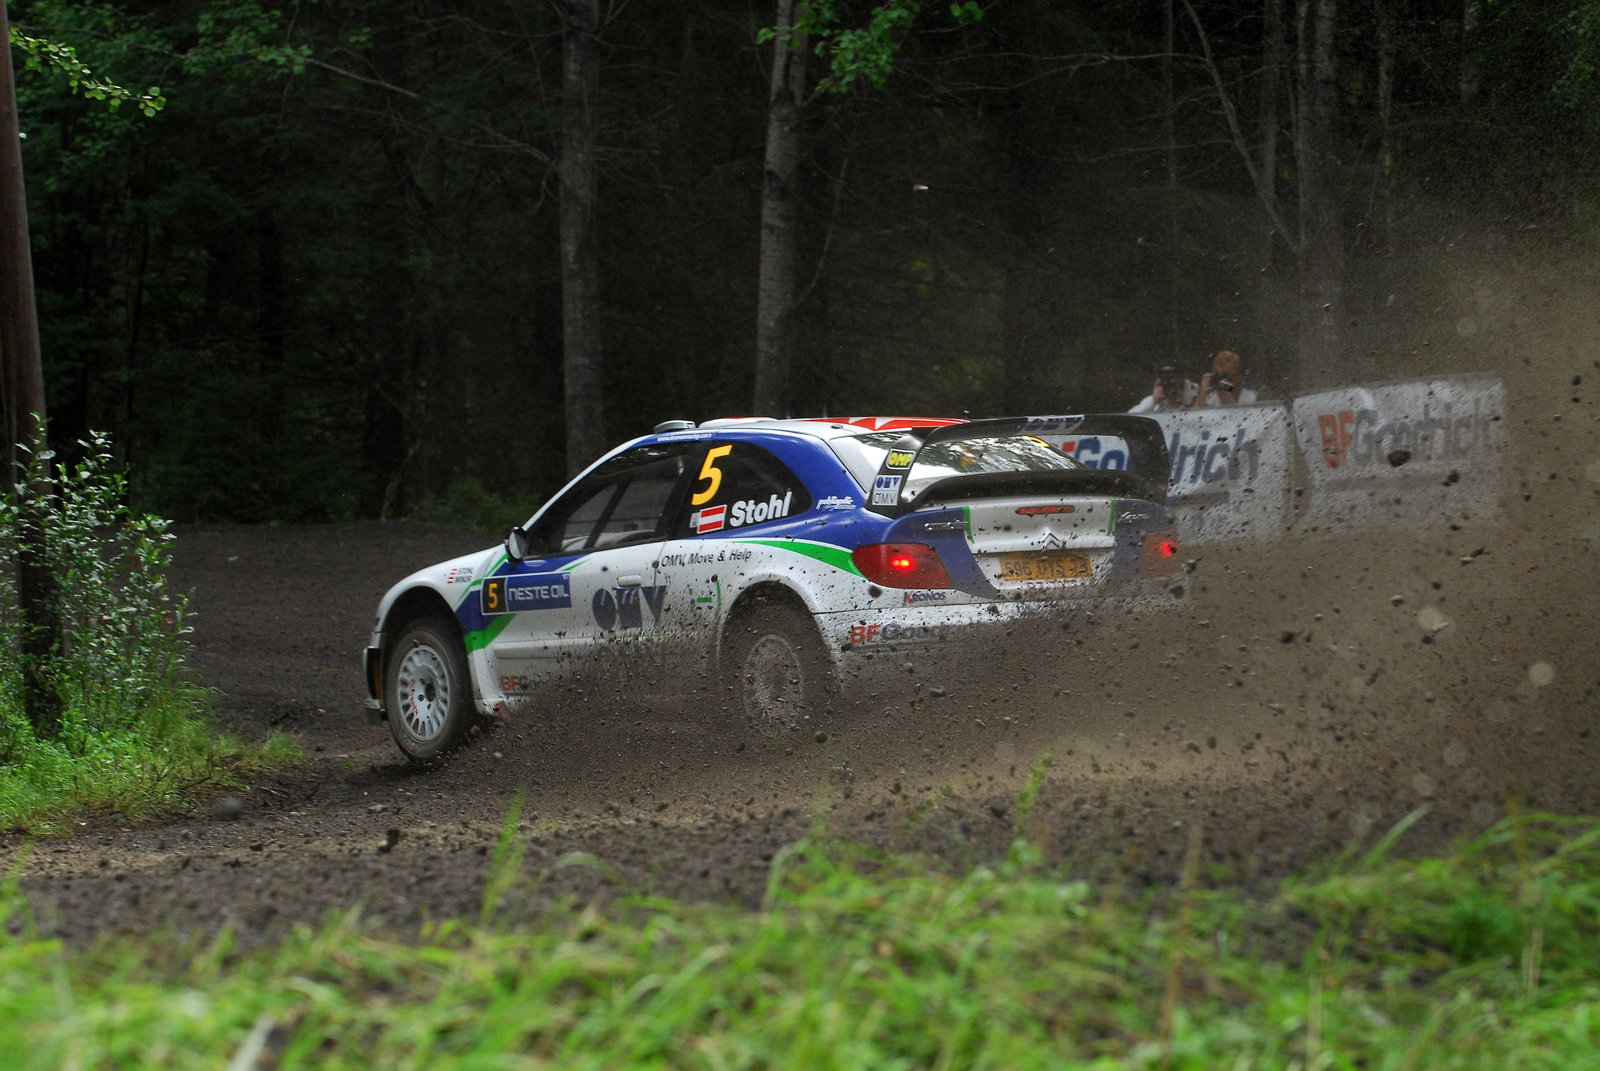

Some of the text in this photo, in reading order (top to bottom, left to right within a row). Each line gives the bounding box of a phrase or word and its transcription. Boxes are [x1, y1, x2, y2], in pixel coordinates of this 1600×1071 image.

[888, 452, 914, 466] OMP
[691, 444, 733, 506] 5
[876, 477, 900, 489] OMV
[729, 490, 793, 527] Stohl
[688, 552, 714, 565] Move
[717, 550, 725, 562] &
[729, 549, 752, 562] Help
[488, 583, 498, 608] 5
[508, 584, 570, 601] NESTE OIL
[592, 585, 667, 631] OMV
